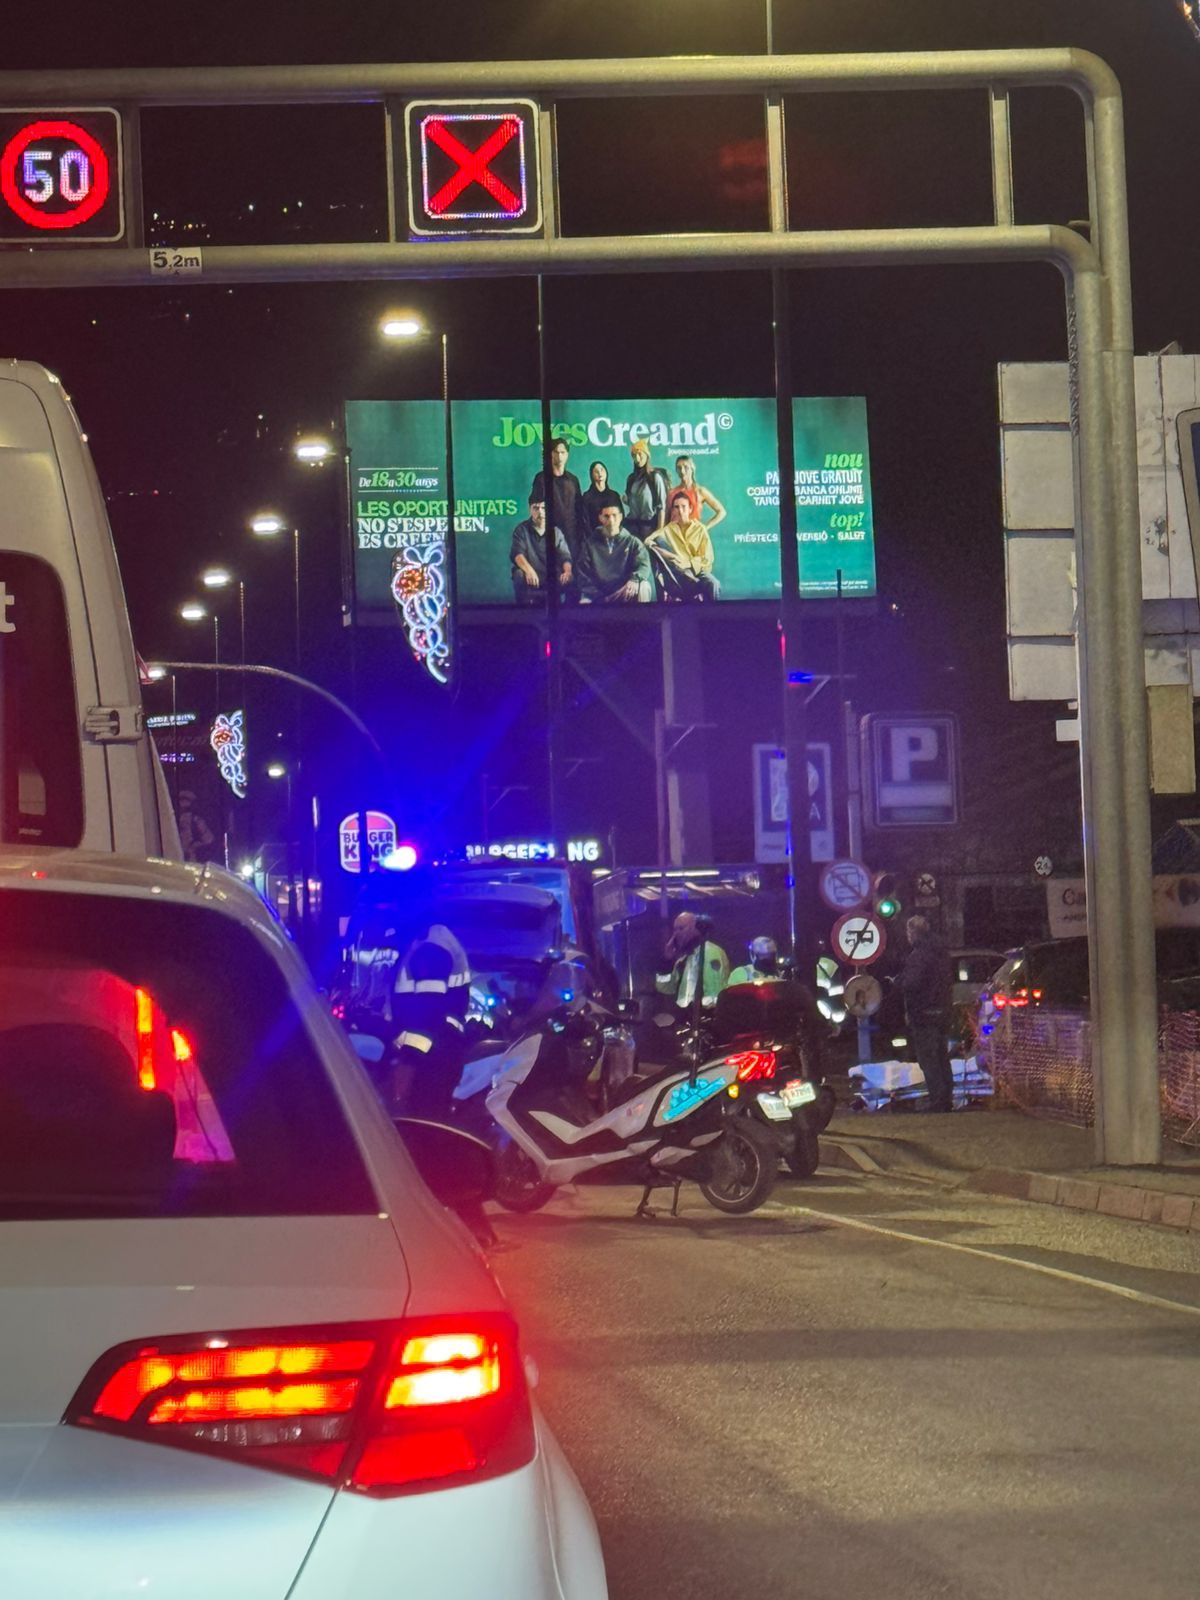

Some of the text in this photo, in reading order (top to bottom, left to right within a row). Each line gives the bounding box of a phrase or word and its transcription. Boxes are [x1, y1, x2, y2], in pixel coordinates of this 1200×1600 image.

[23, 150, 89, 203] 50
[153, 251, 200, 270] 5,2m
[824, 453, 864, 468] nou
[395, 471, 416, 487] 30
[357, 501, 390, 517] LES
[357, 517, 385, 533] NO
[830, 512, 865, 531] top!
[358, 533, 381, 549] ES
[890, 727, 938, 781] P
[343, 831, 394, 844] BUGER
[343, 843, 394, 859] KNG
